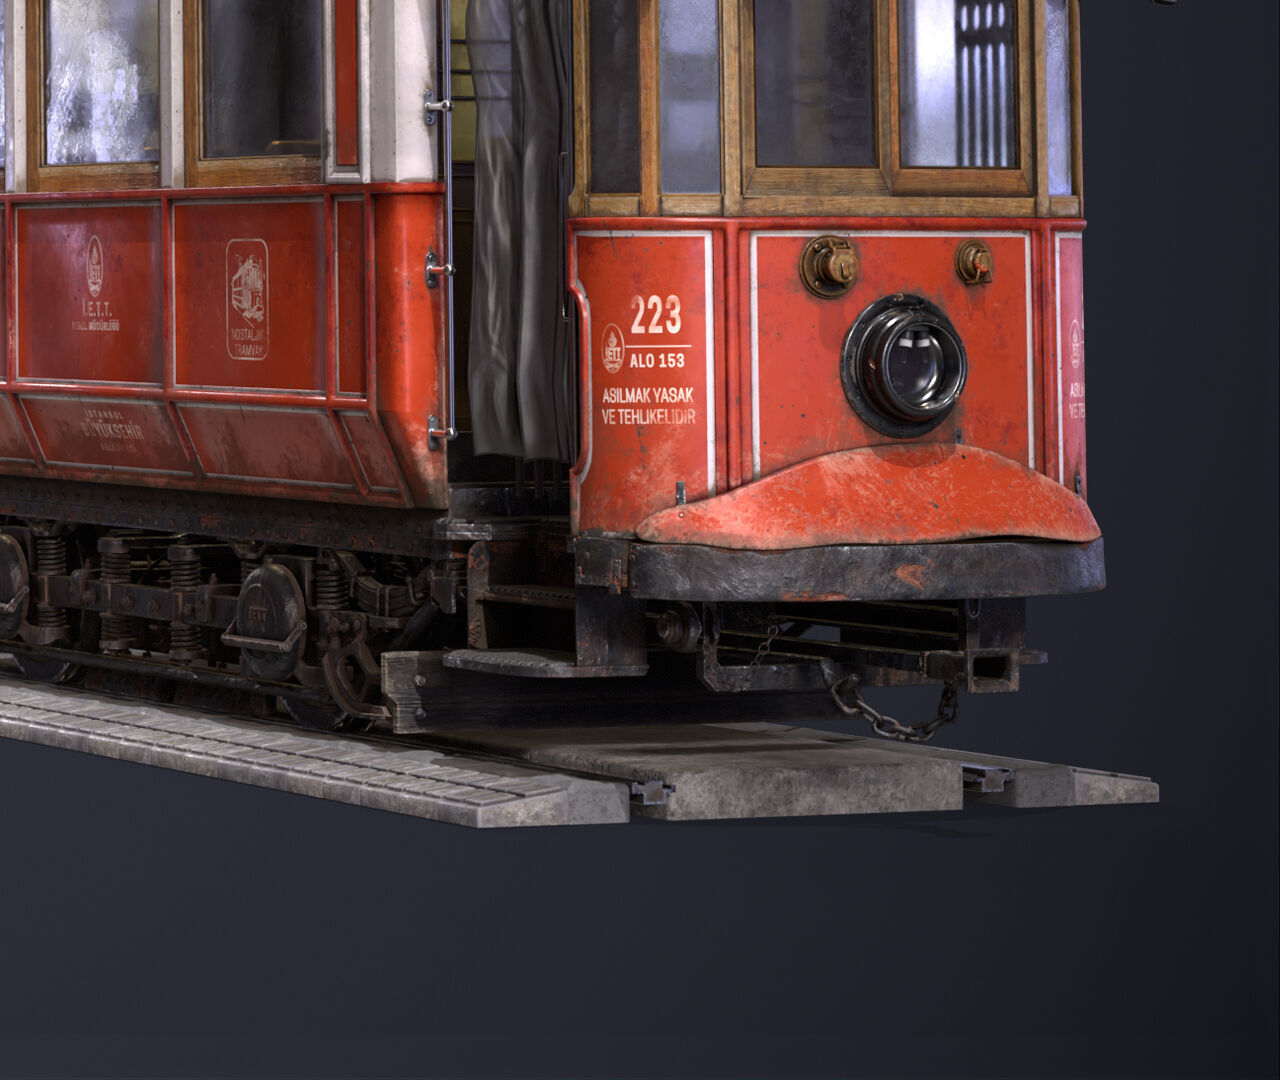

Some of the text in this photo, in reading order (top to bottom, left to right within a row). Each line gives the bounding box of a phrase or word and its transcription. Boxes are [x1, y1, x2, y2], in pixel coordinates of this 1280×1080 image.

[630, 294, 682, 334] 223
[630, 353, 685, 368] ALO 153
[602, 387, 694, 403] ASILMAK YASAK
[601, 409, 616, 425] VE
